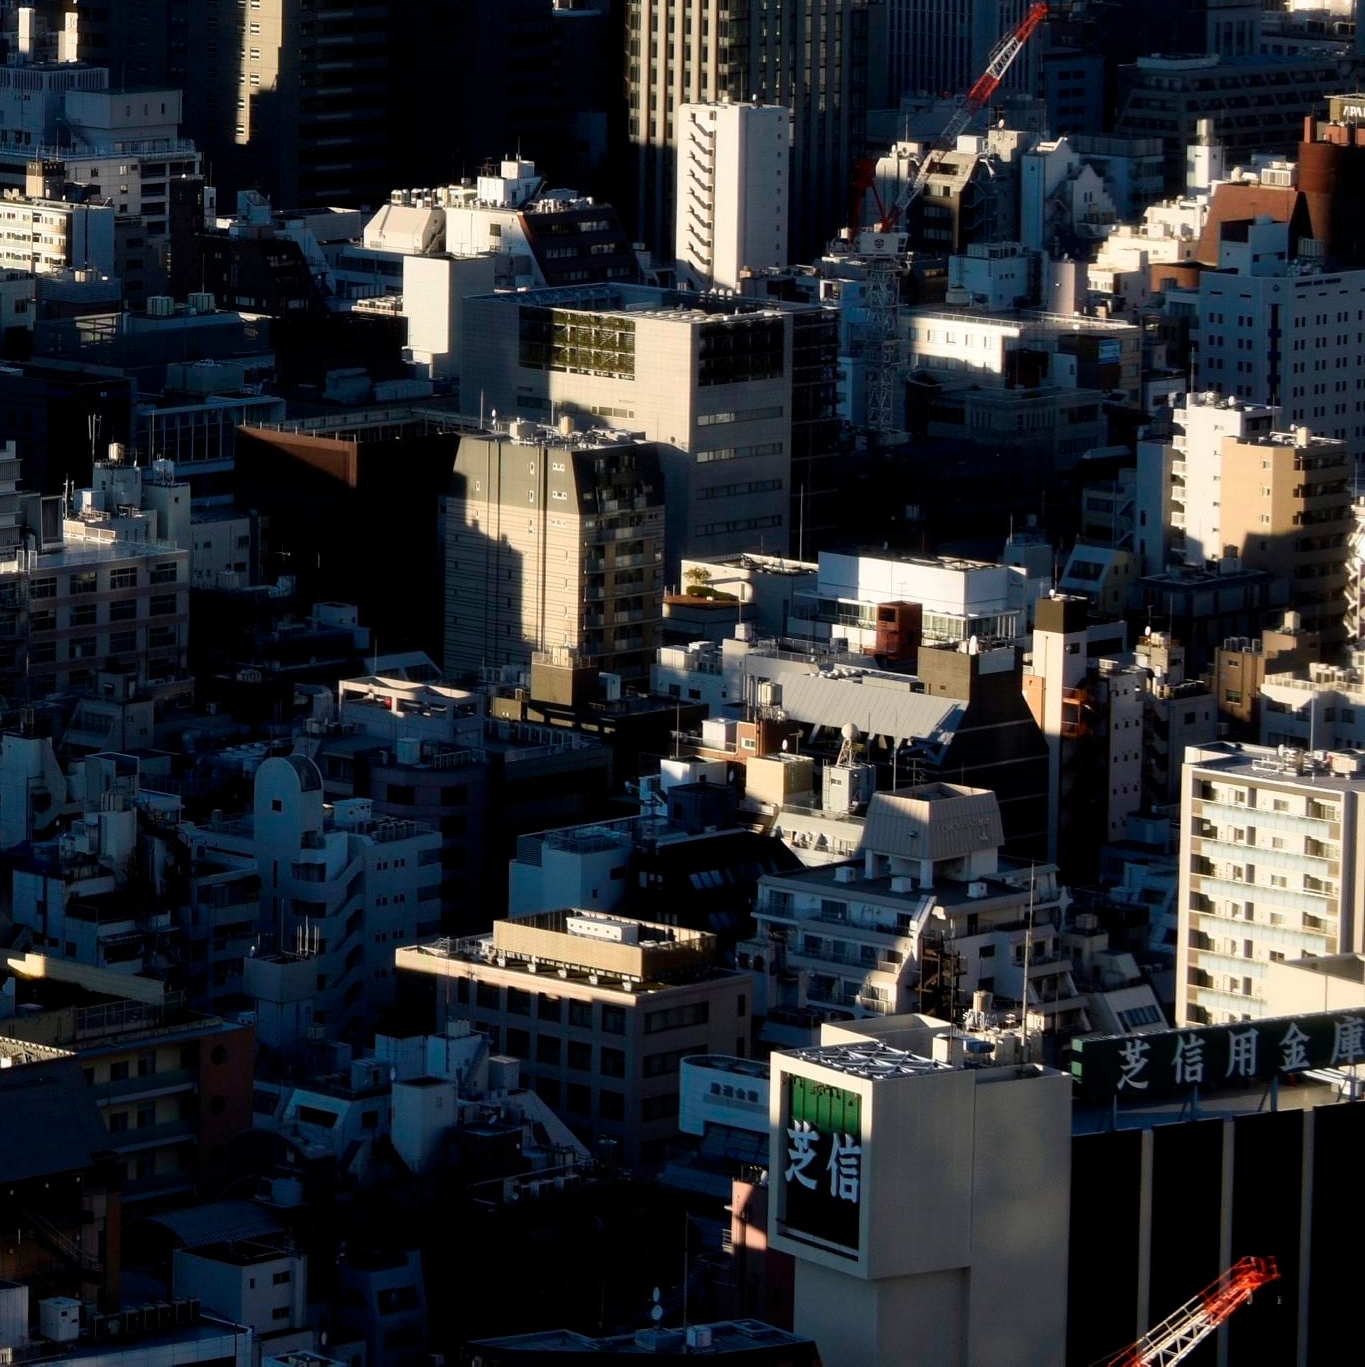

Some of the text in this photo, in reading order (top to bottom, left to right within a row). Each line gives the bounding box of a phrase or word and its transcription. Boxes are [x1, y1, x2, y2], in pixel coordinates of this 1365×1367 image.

[1116, 1015, 1365, 1091] 芝信用金庫
[784, 1118, 861, 1205] 芝信
